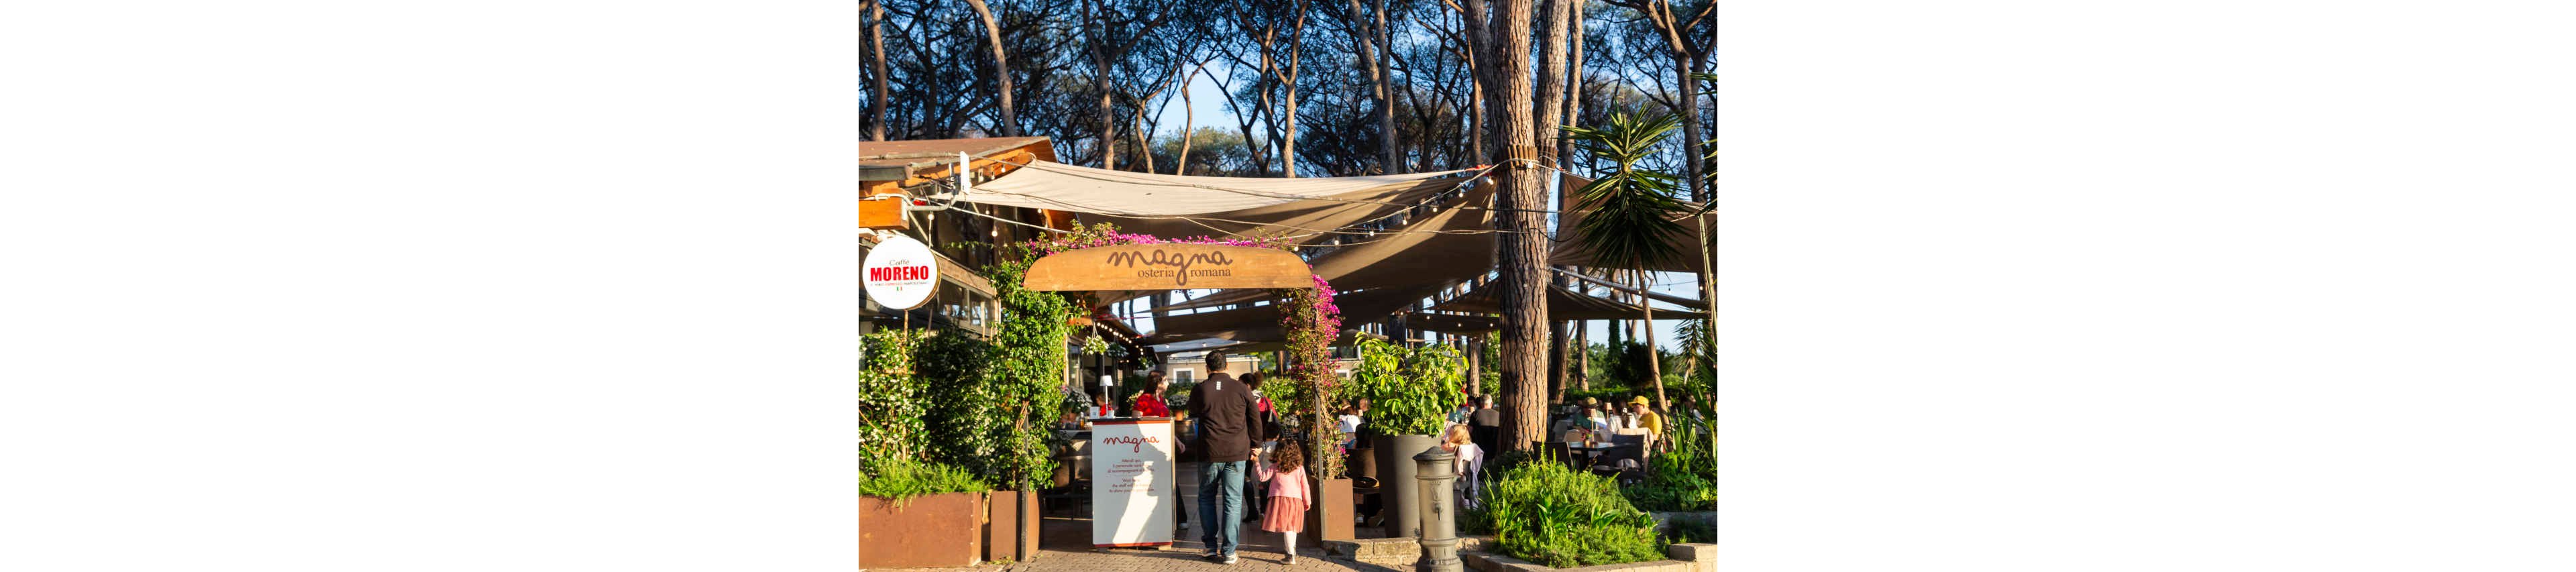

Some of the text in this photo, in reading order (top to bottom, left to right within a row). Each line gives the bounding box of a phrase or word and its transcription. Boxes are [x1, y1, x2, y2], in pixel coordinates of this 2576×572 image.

[870, 266, 929, 282] MORENO
[1106, 248, 1234, 287] magna
[1137, 266, 1232, 278] osteria romana
[1103, 436, 1160, 453] magna
